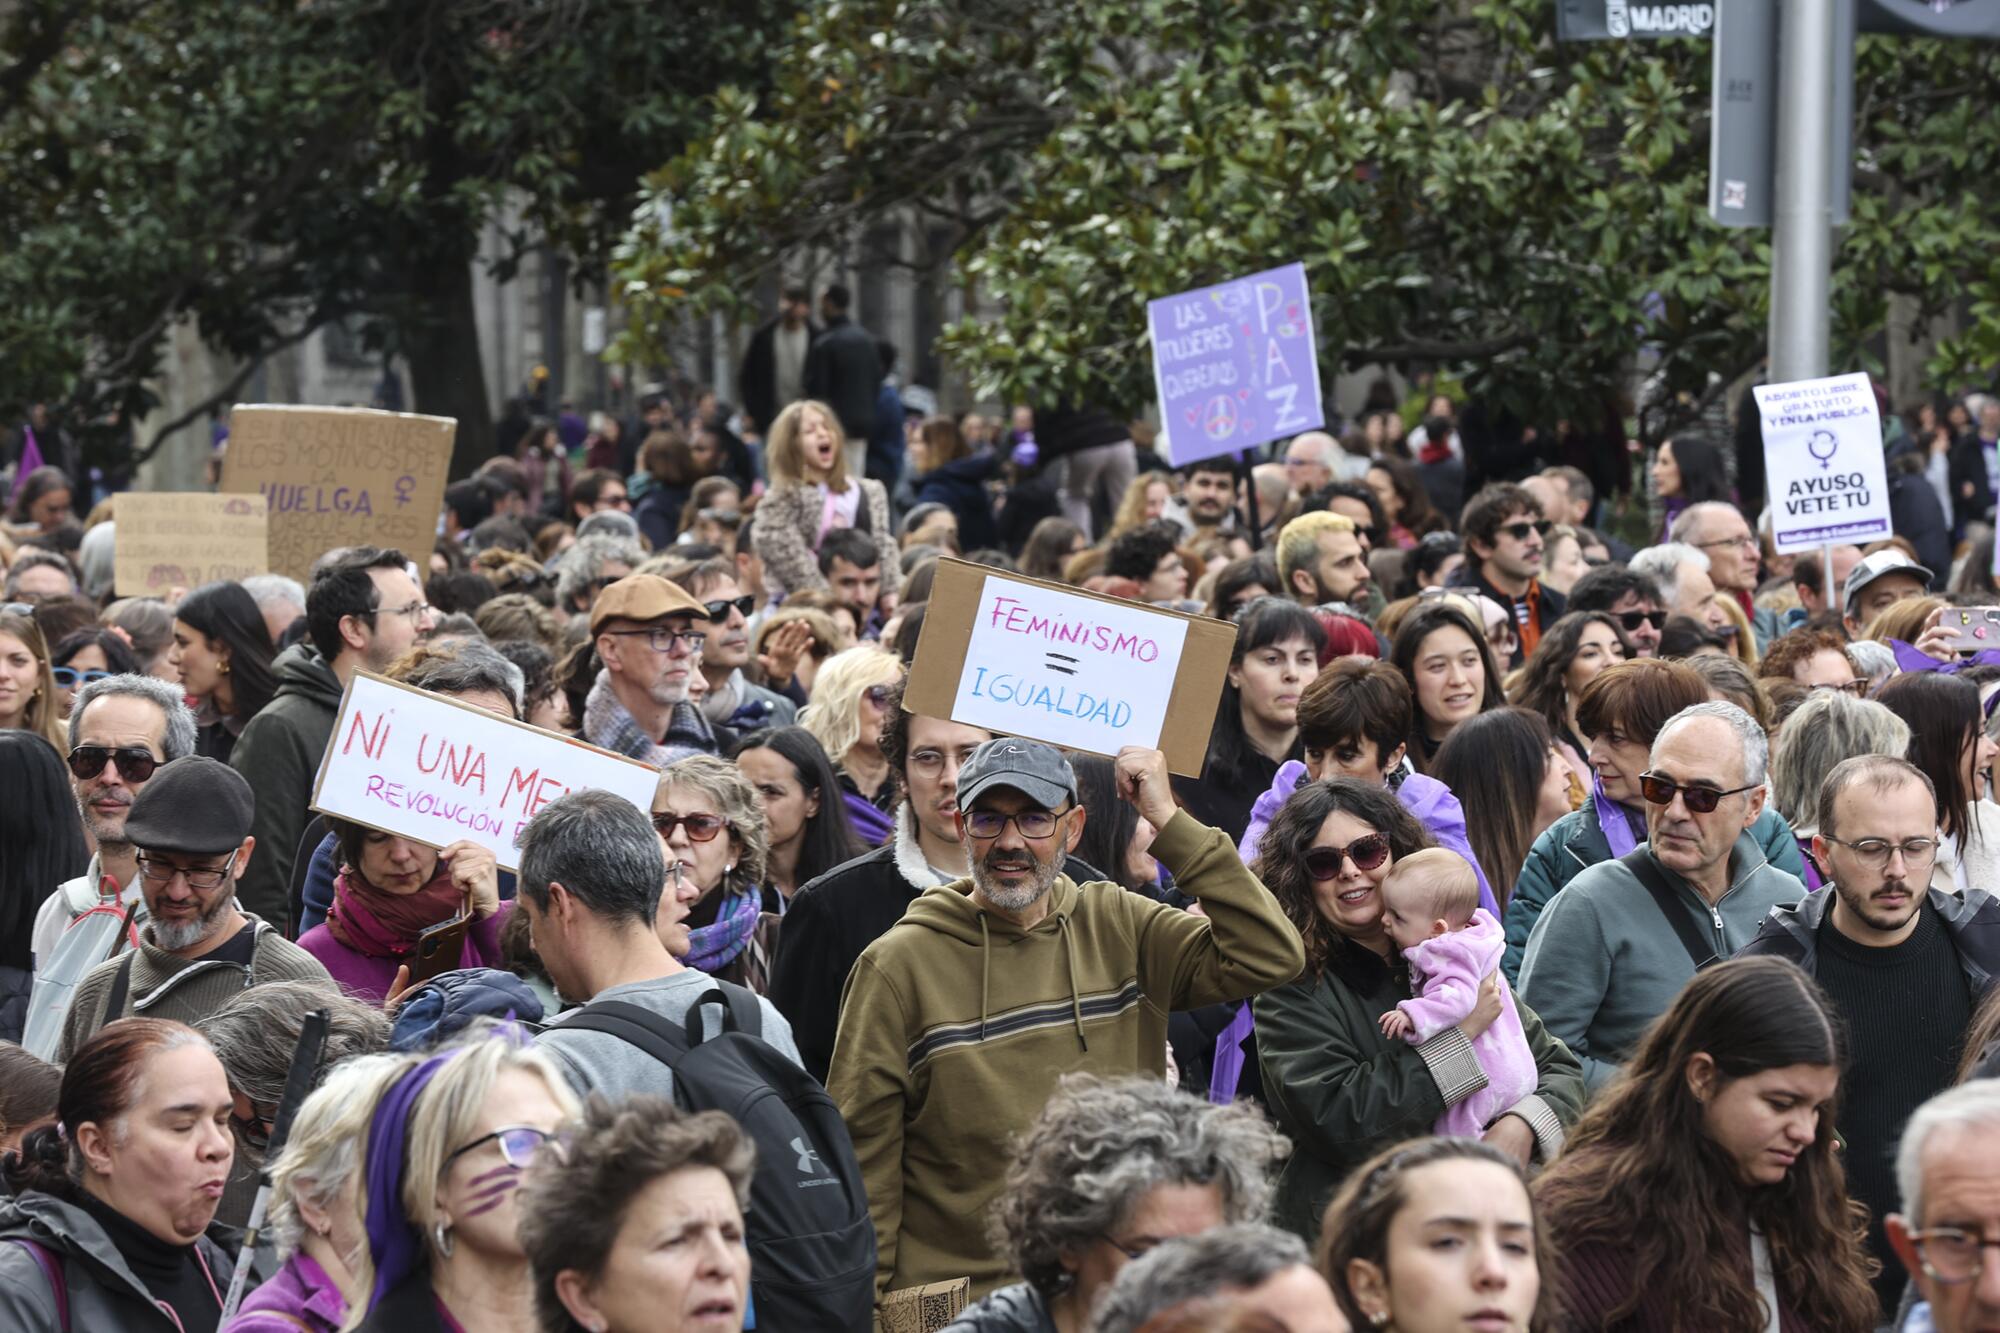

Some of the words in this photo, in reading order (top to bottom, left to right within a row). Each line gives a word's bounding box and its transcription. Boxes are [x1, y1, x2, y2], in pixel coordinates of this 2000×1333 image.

[1630, 4, 1713, 34] MADRID
[1174, 301, 1207, 330] LAS
[1765, 389, 1820, 402] ABORTO
[1783, 395, 1852, 413] GRATUITO
[1770, 417, 1778, 426] Y
[1780, 415, 1796, 425] EN
[1800, 414, 1814, 423] LA
[238, 442, 288, 470] LOS
[404, 447, 437, 478] DE
[311, 470, 336, 484] LA
[1789, 473, 1864, 496] AYUSO
[260, 481, 373, 517] HUELGA
[1785, 495, 1839, 515] VETE
[971, 667, 1131, 728] IGUALDAD
[417, 734, 485, 795] UNA
